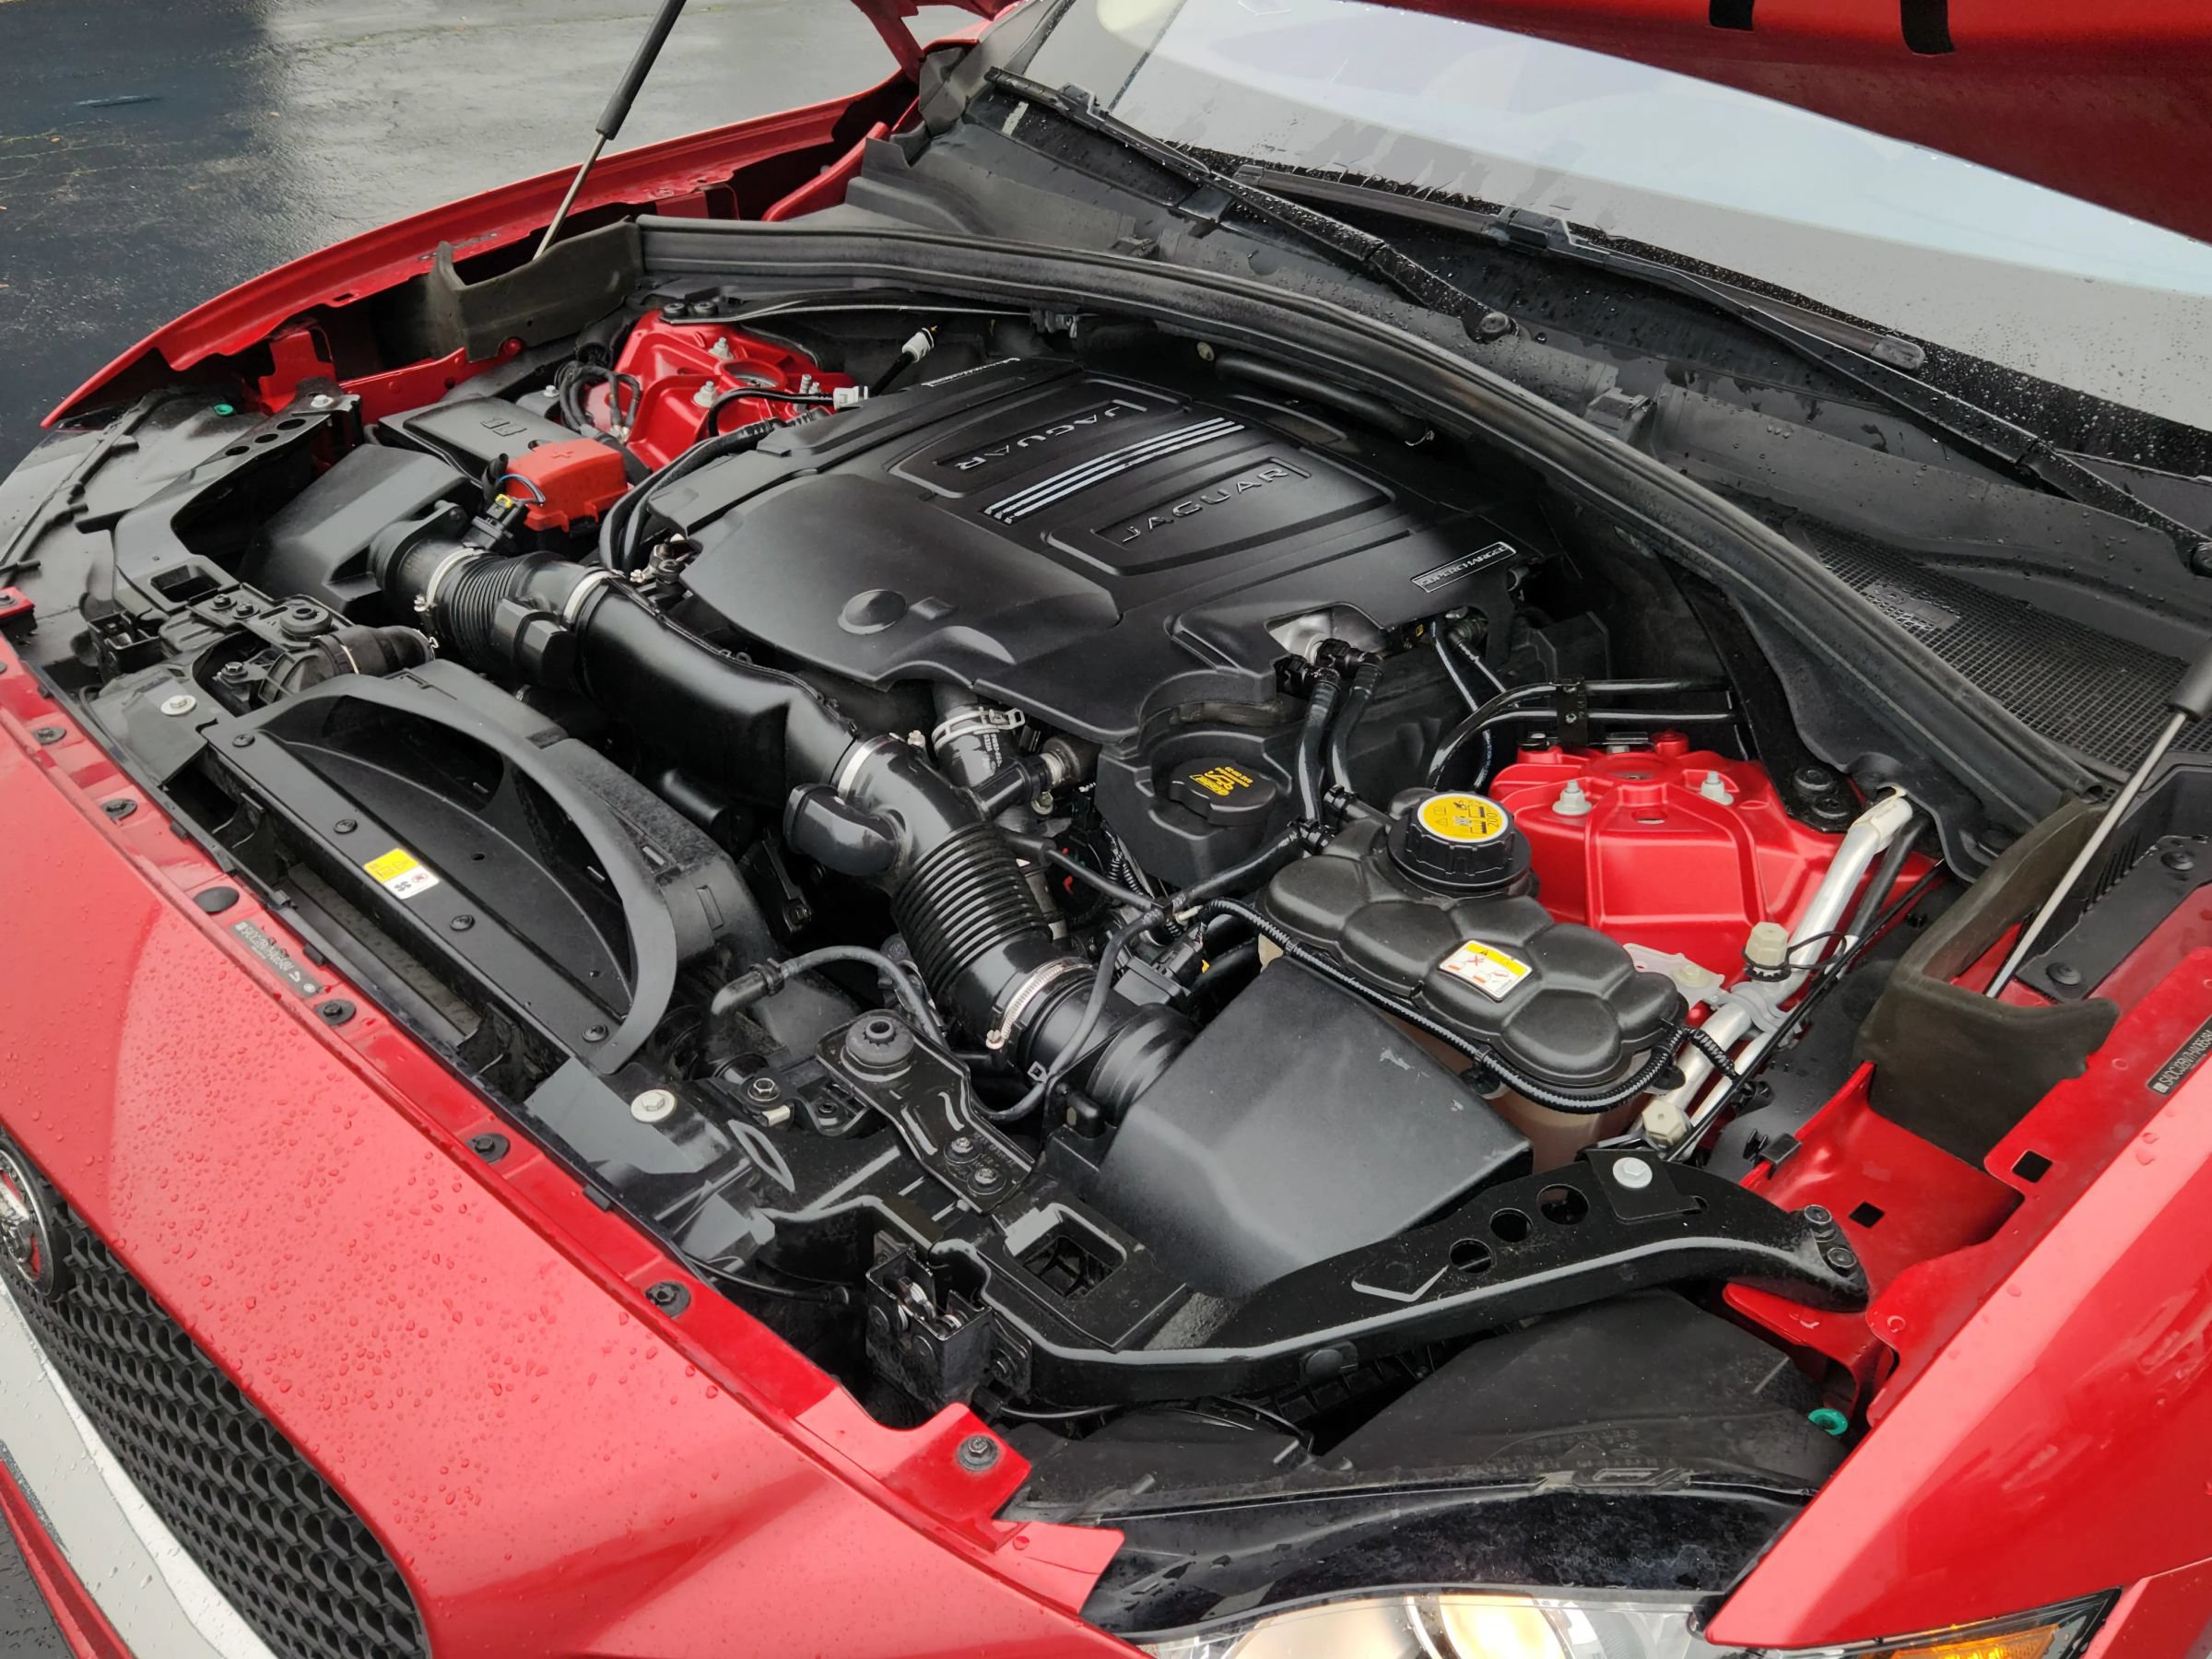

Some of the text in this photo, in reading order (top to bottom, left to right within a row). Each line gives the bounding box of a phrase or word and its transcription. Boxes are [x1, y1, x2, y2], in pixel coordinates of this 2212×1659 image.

[954, 406, 1122, 471] JAGUAR
[1121, 467, 1289, 544] JAGUAR
[1419, 546, 1510, 587] SUPERCHARGED
